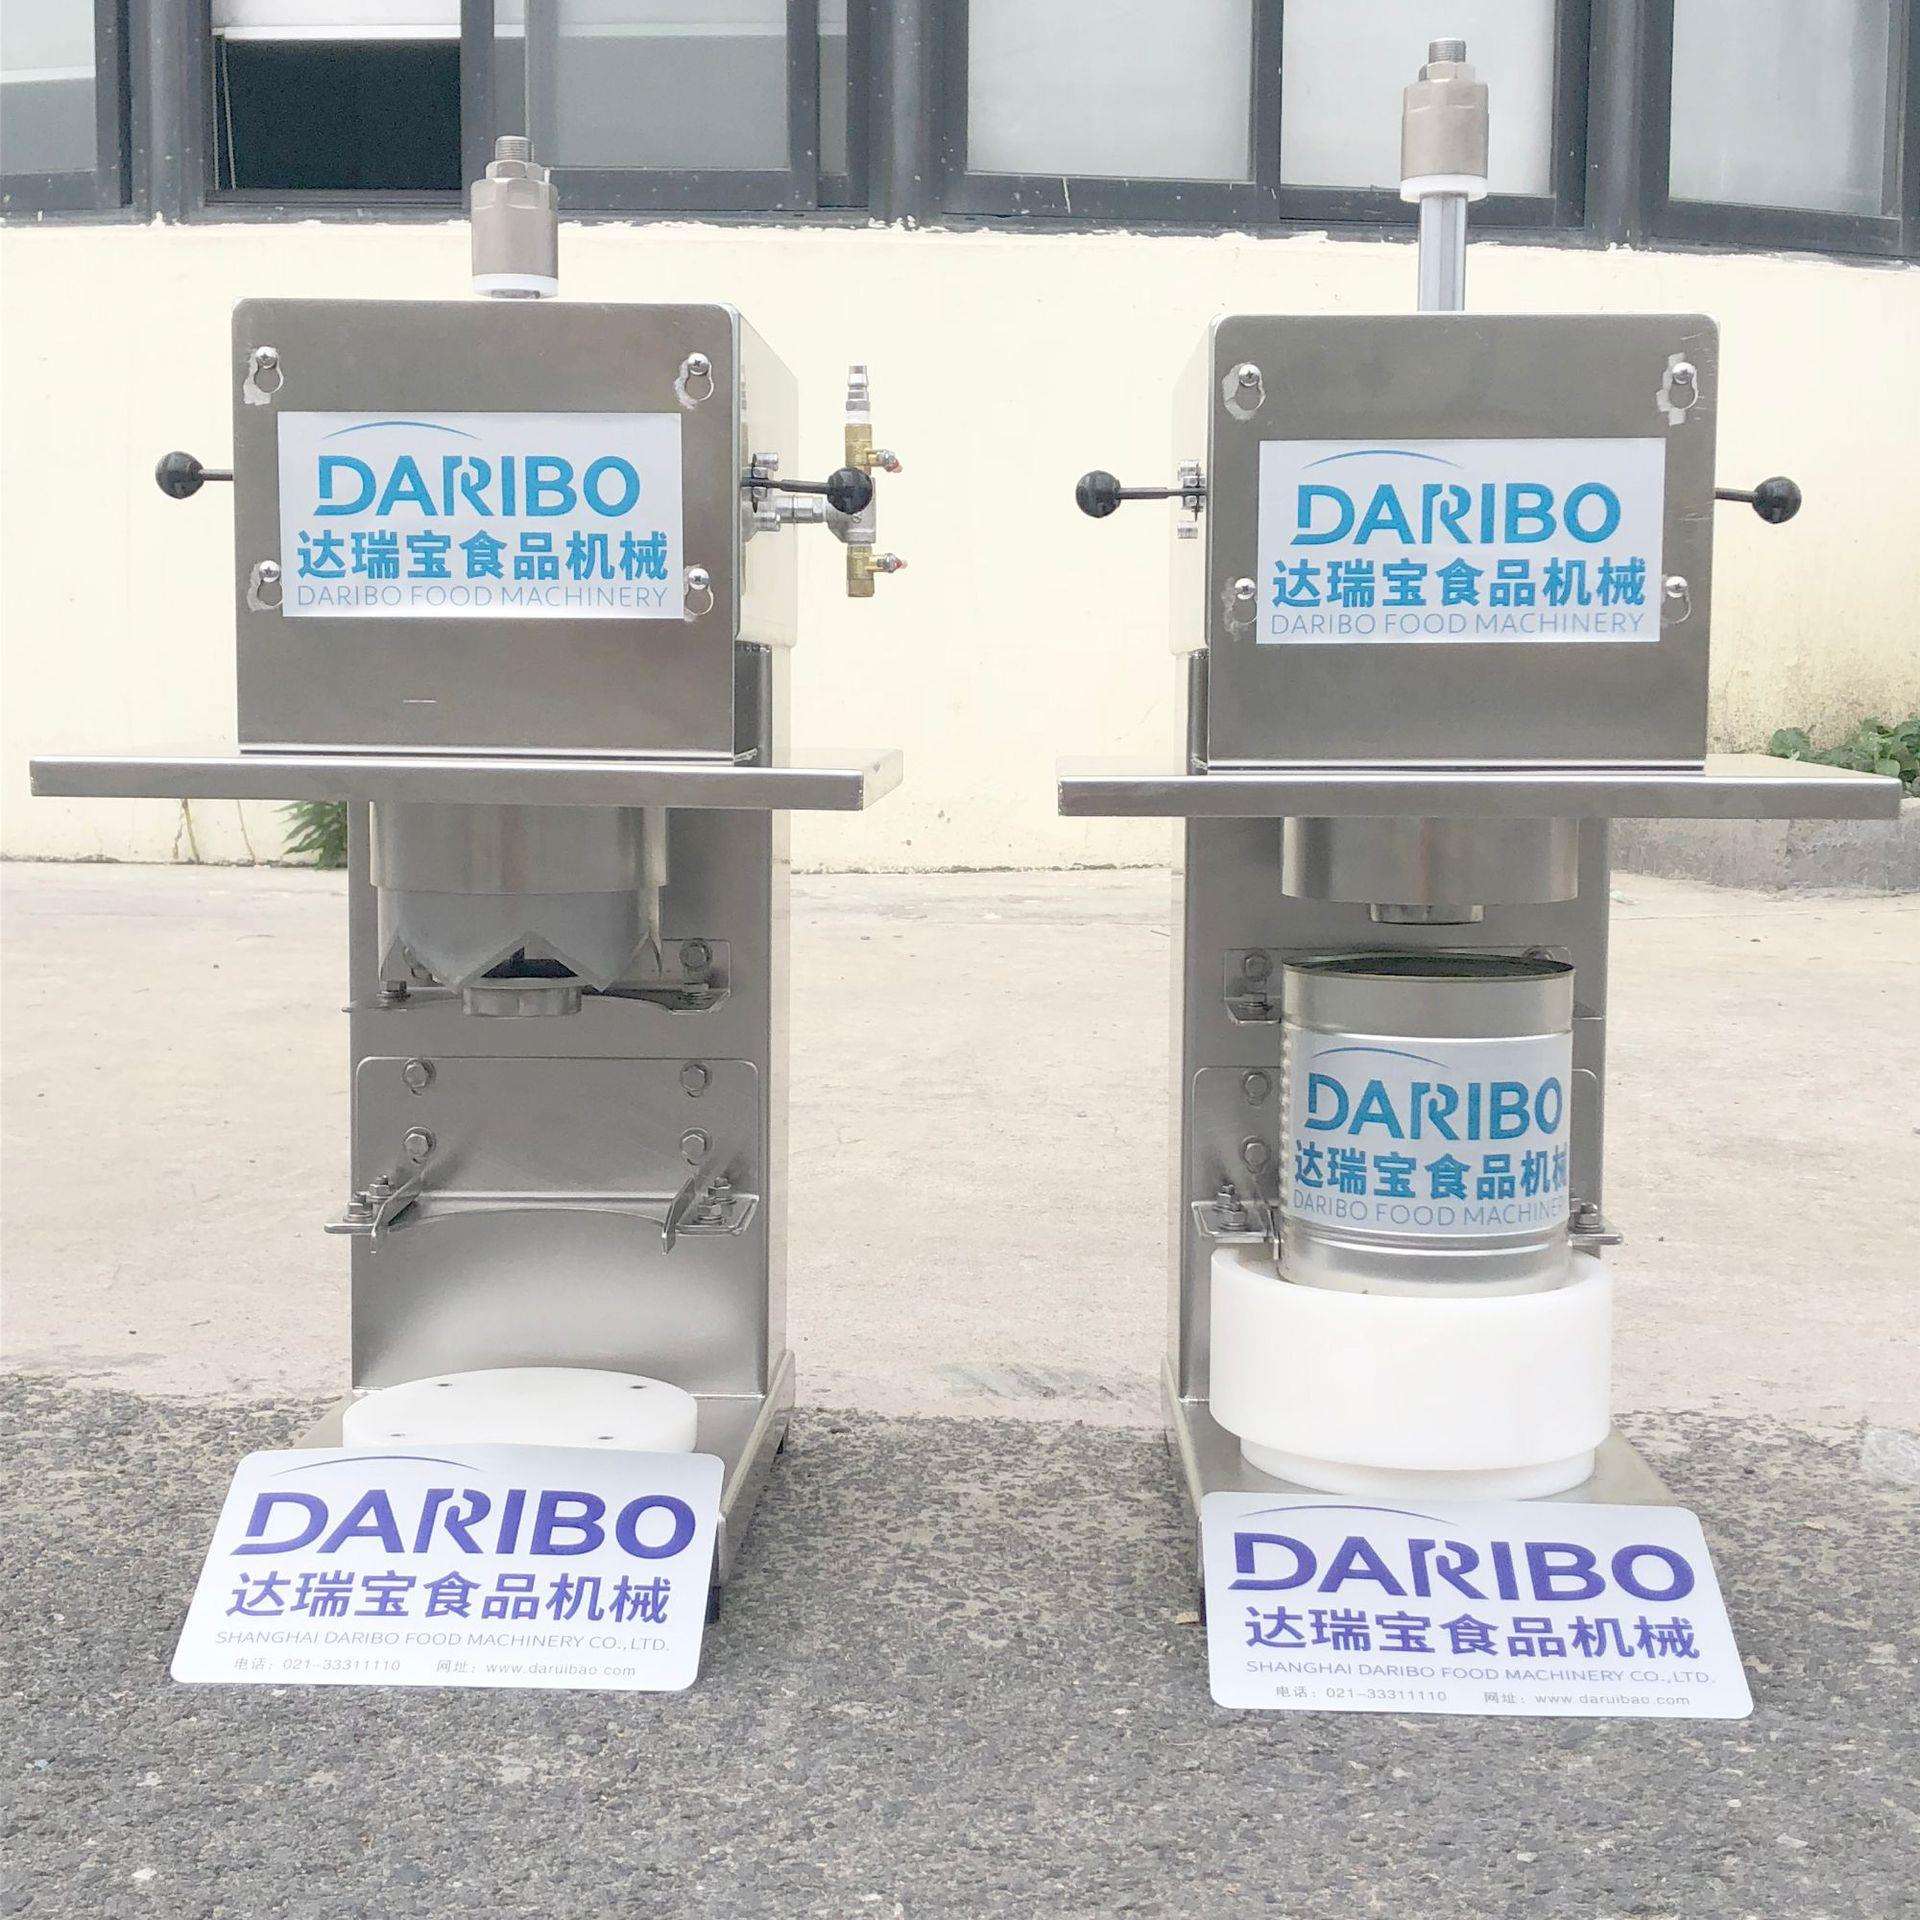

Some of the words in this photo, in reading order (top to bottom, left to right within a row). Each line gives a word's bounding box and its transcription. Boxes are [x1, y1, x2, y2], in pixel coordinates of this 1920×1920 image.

[313, 455, 641, 517] DARIBO
[1290, 482, 1621, 545] DARIBO
[297, 529, 669, 581] 达瑞宝食品机械
[297, 585, 401, 607] DARIBO
[411, 585, 492, 607] FOOD
[501, 585, 668, 608] MACHINERY
[1272, 556, 1646, 608] 达瑞宝食品机械
[1271, 613, 1375, 635] DARIBO
[1384, 612, 1466, 635] FOOD
[1475, 612, 1644, 634] MACHINERY
[1304, 1072, 1563, 1141] DARIBO
[1294, 1189, 1368, 1221] DARIBO
[1376, 1203, 1455, 1226] FOOD
[229, 1488, 696, 1560] DARIBO
[1227, 1532, 1695, 1602] DARIBO
[226, 1570, 671, 1625] 达瑞宝食品机械
[215, 1631, 319, 1645] SHANGHAI
[324, 1631, 400, 1645] DARIBO
[406, 1632, 461, 1646] FOOD
[467, 1633, 585, 1648] MACHINERY
[1245, 1605, 1700, 1661] 达瑞宝食品机械
[1246, 1660, 1351, 1675] SHANGHAI
[1359, 1664, 1435, 1678] DARIBO
[1442, 1667, 1499, 1680] FOOD
[1505, 1669, 1624, 1682] MACHINERY
